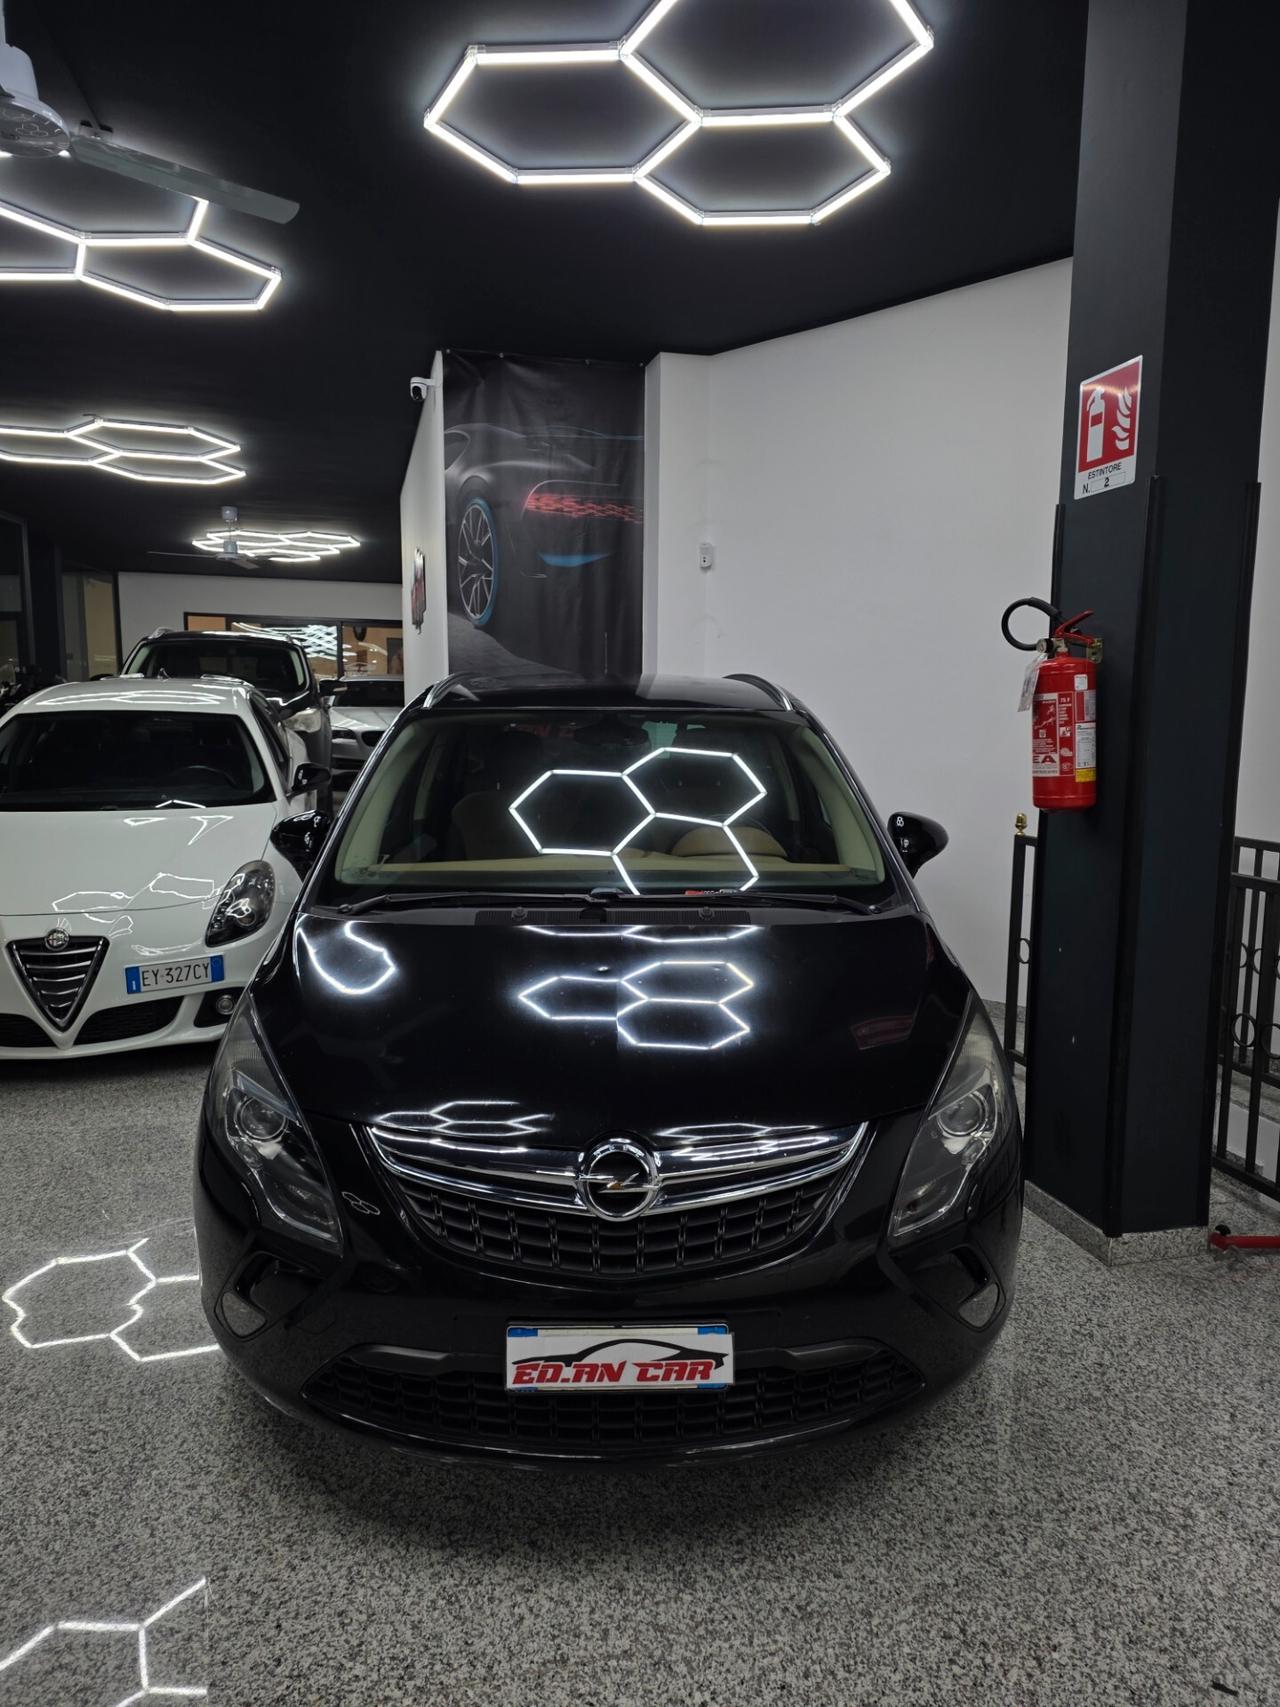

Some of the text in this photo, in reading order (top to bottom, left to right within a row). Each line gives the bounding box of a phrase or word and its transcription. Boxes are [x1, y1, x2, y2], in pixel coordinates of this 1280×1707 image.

[1088, 462, 1122, 480] ESTINTORE
[1104, 477, 1110, 488] 2
[141, 963, 210, 987] EY 327CY
[512, 1359, 716, 1385] ED.AN CAR
